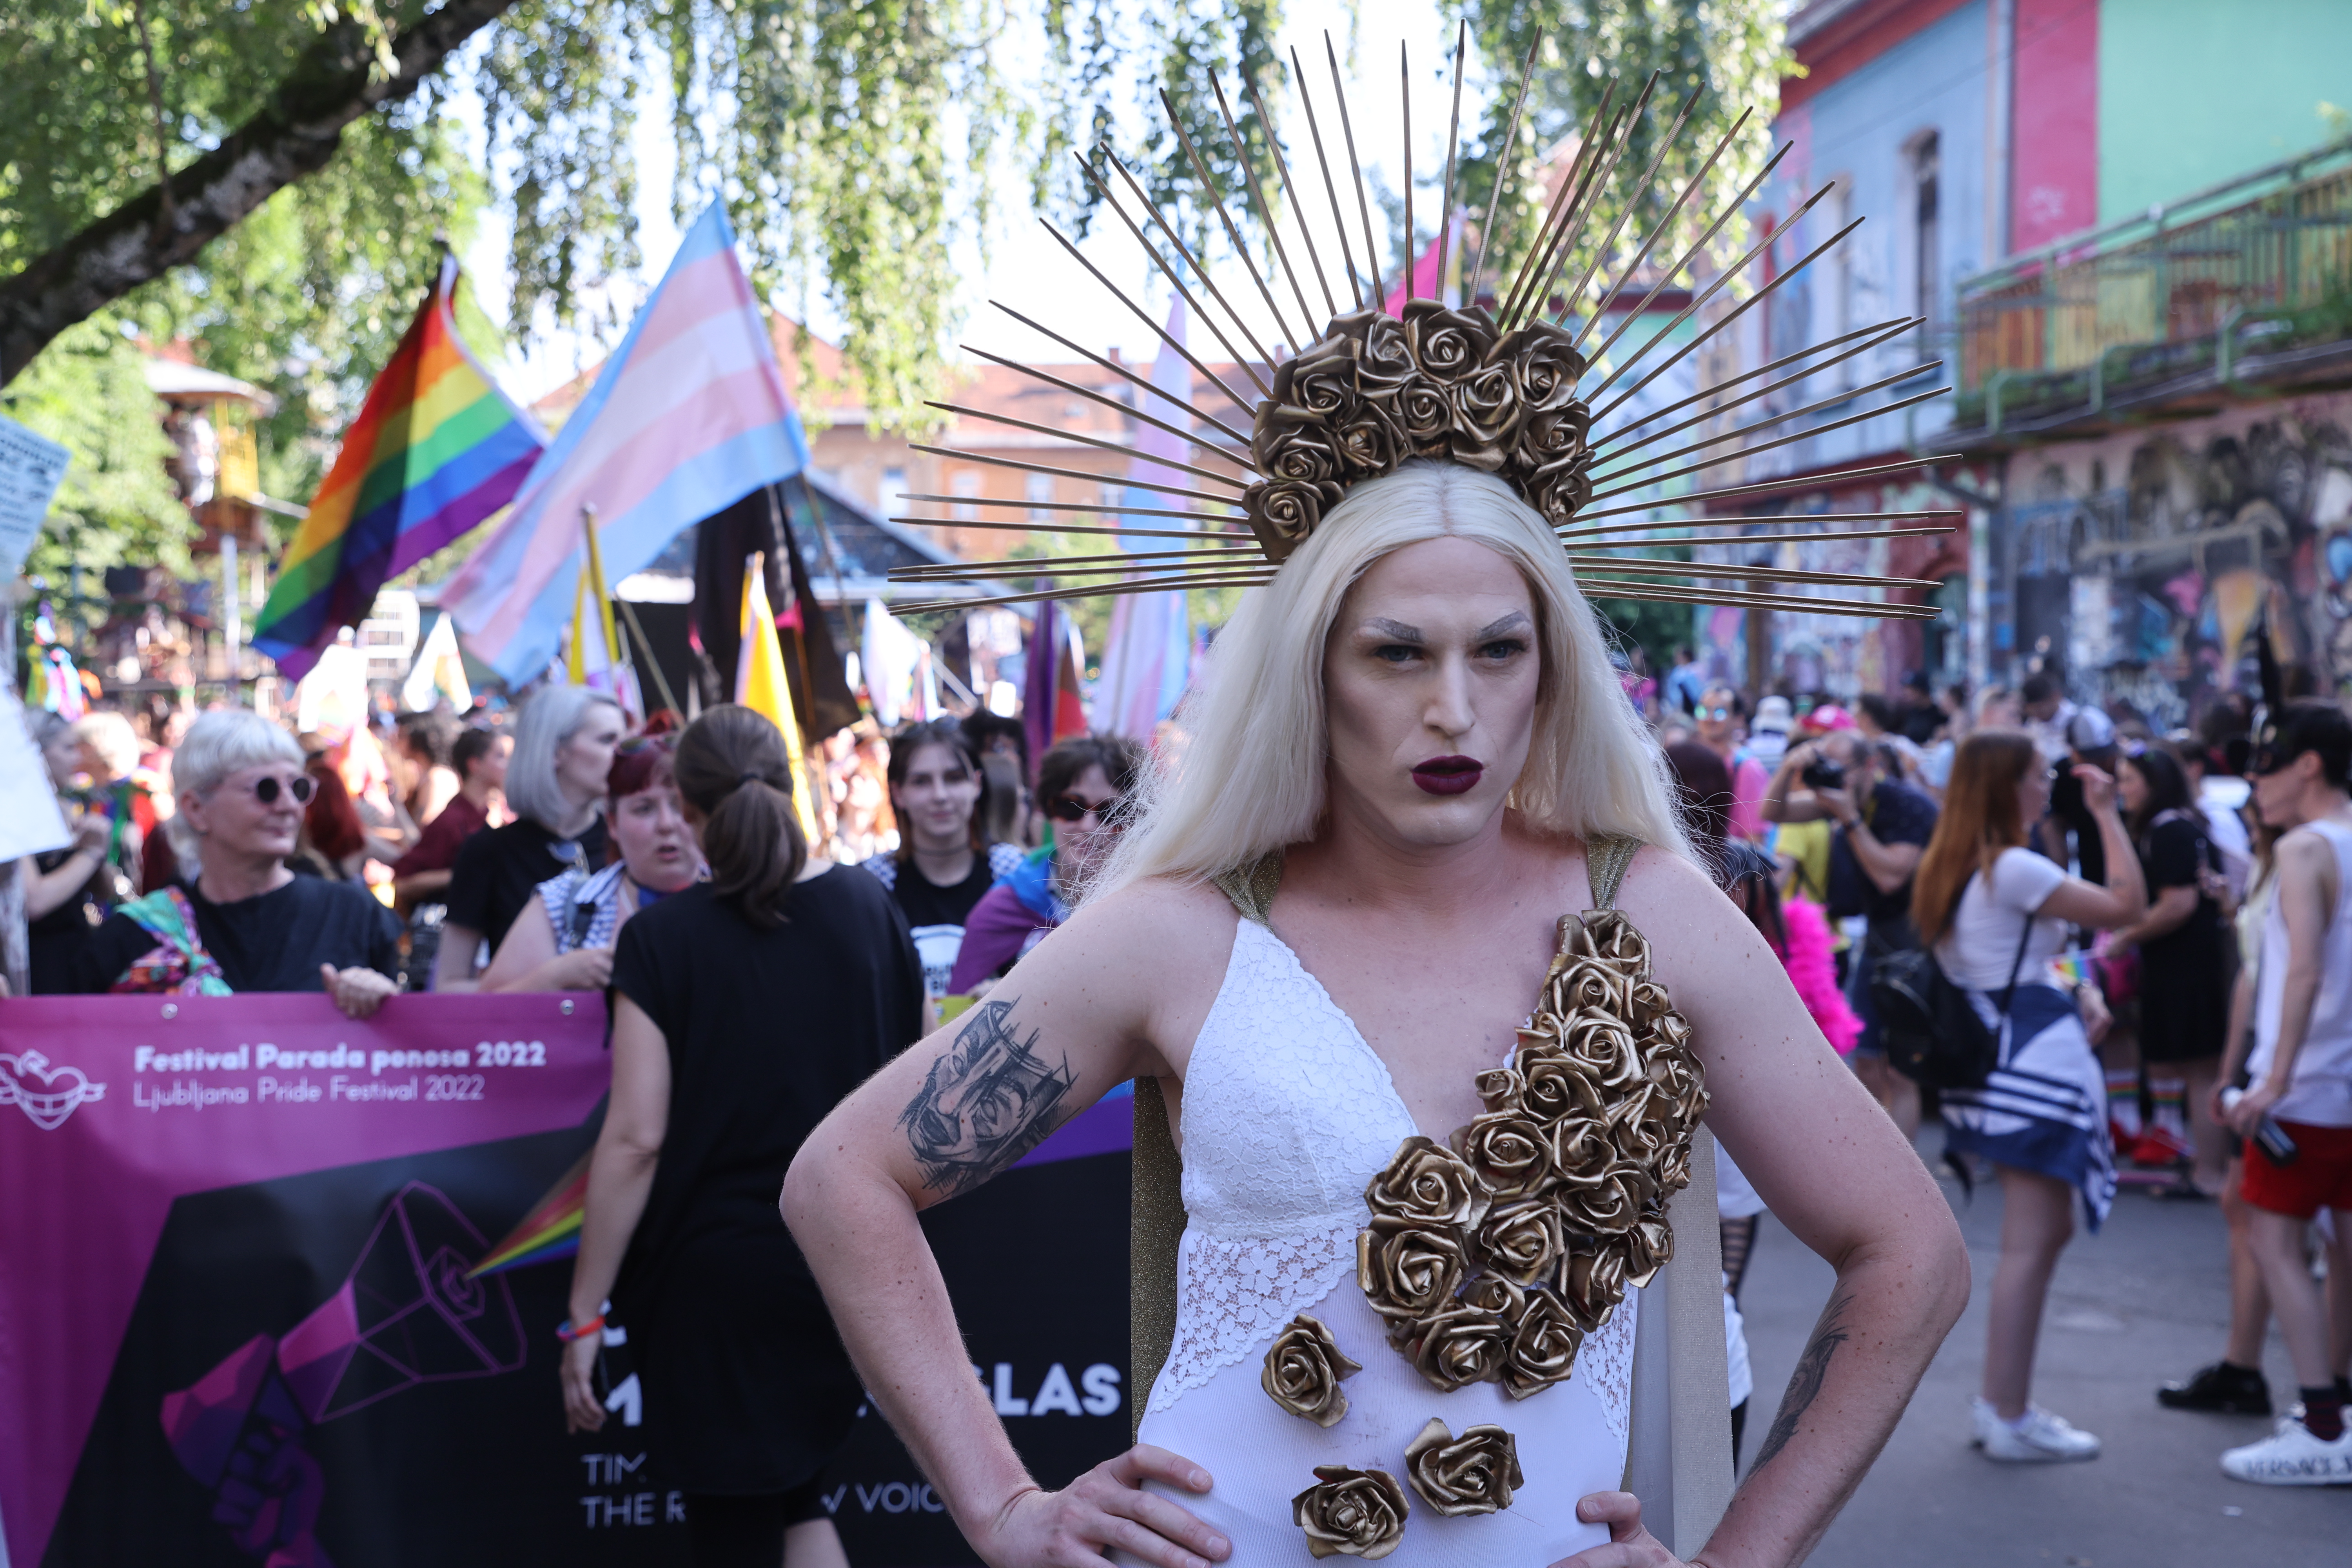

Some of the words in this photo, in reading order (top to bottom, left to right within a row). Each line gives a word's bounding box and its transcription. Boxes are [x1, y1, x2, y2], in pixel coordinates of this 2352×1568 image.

[134, 1043, 250, 1073] Festival
[256, 1042, 366, 1069] Parada
[371, 1049, 470, 1076] ponosa
[475, 1040, 547, 1067] 2022
[134, 1078, 249, 1113] Ljubljana
[258, 1075, 323, 1103] Pride
[330, 1074, 418, 1101] Festival
[424, 1074, 485, 1101] 2022
[974, 1362, 1122, 1417] LAS
[579, 1491, 656, 1528] THE
